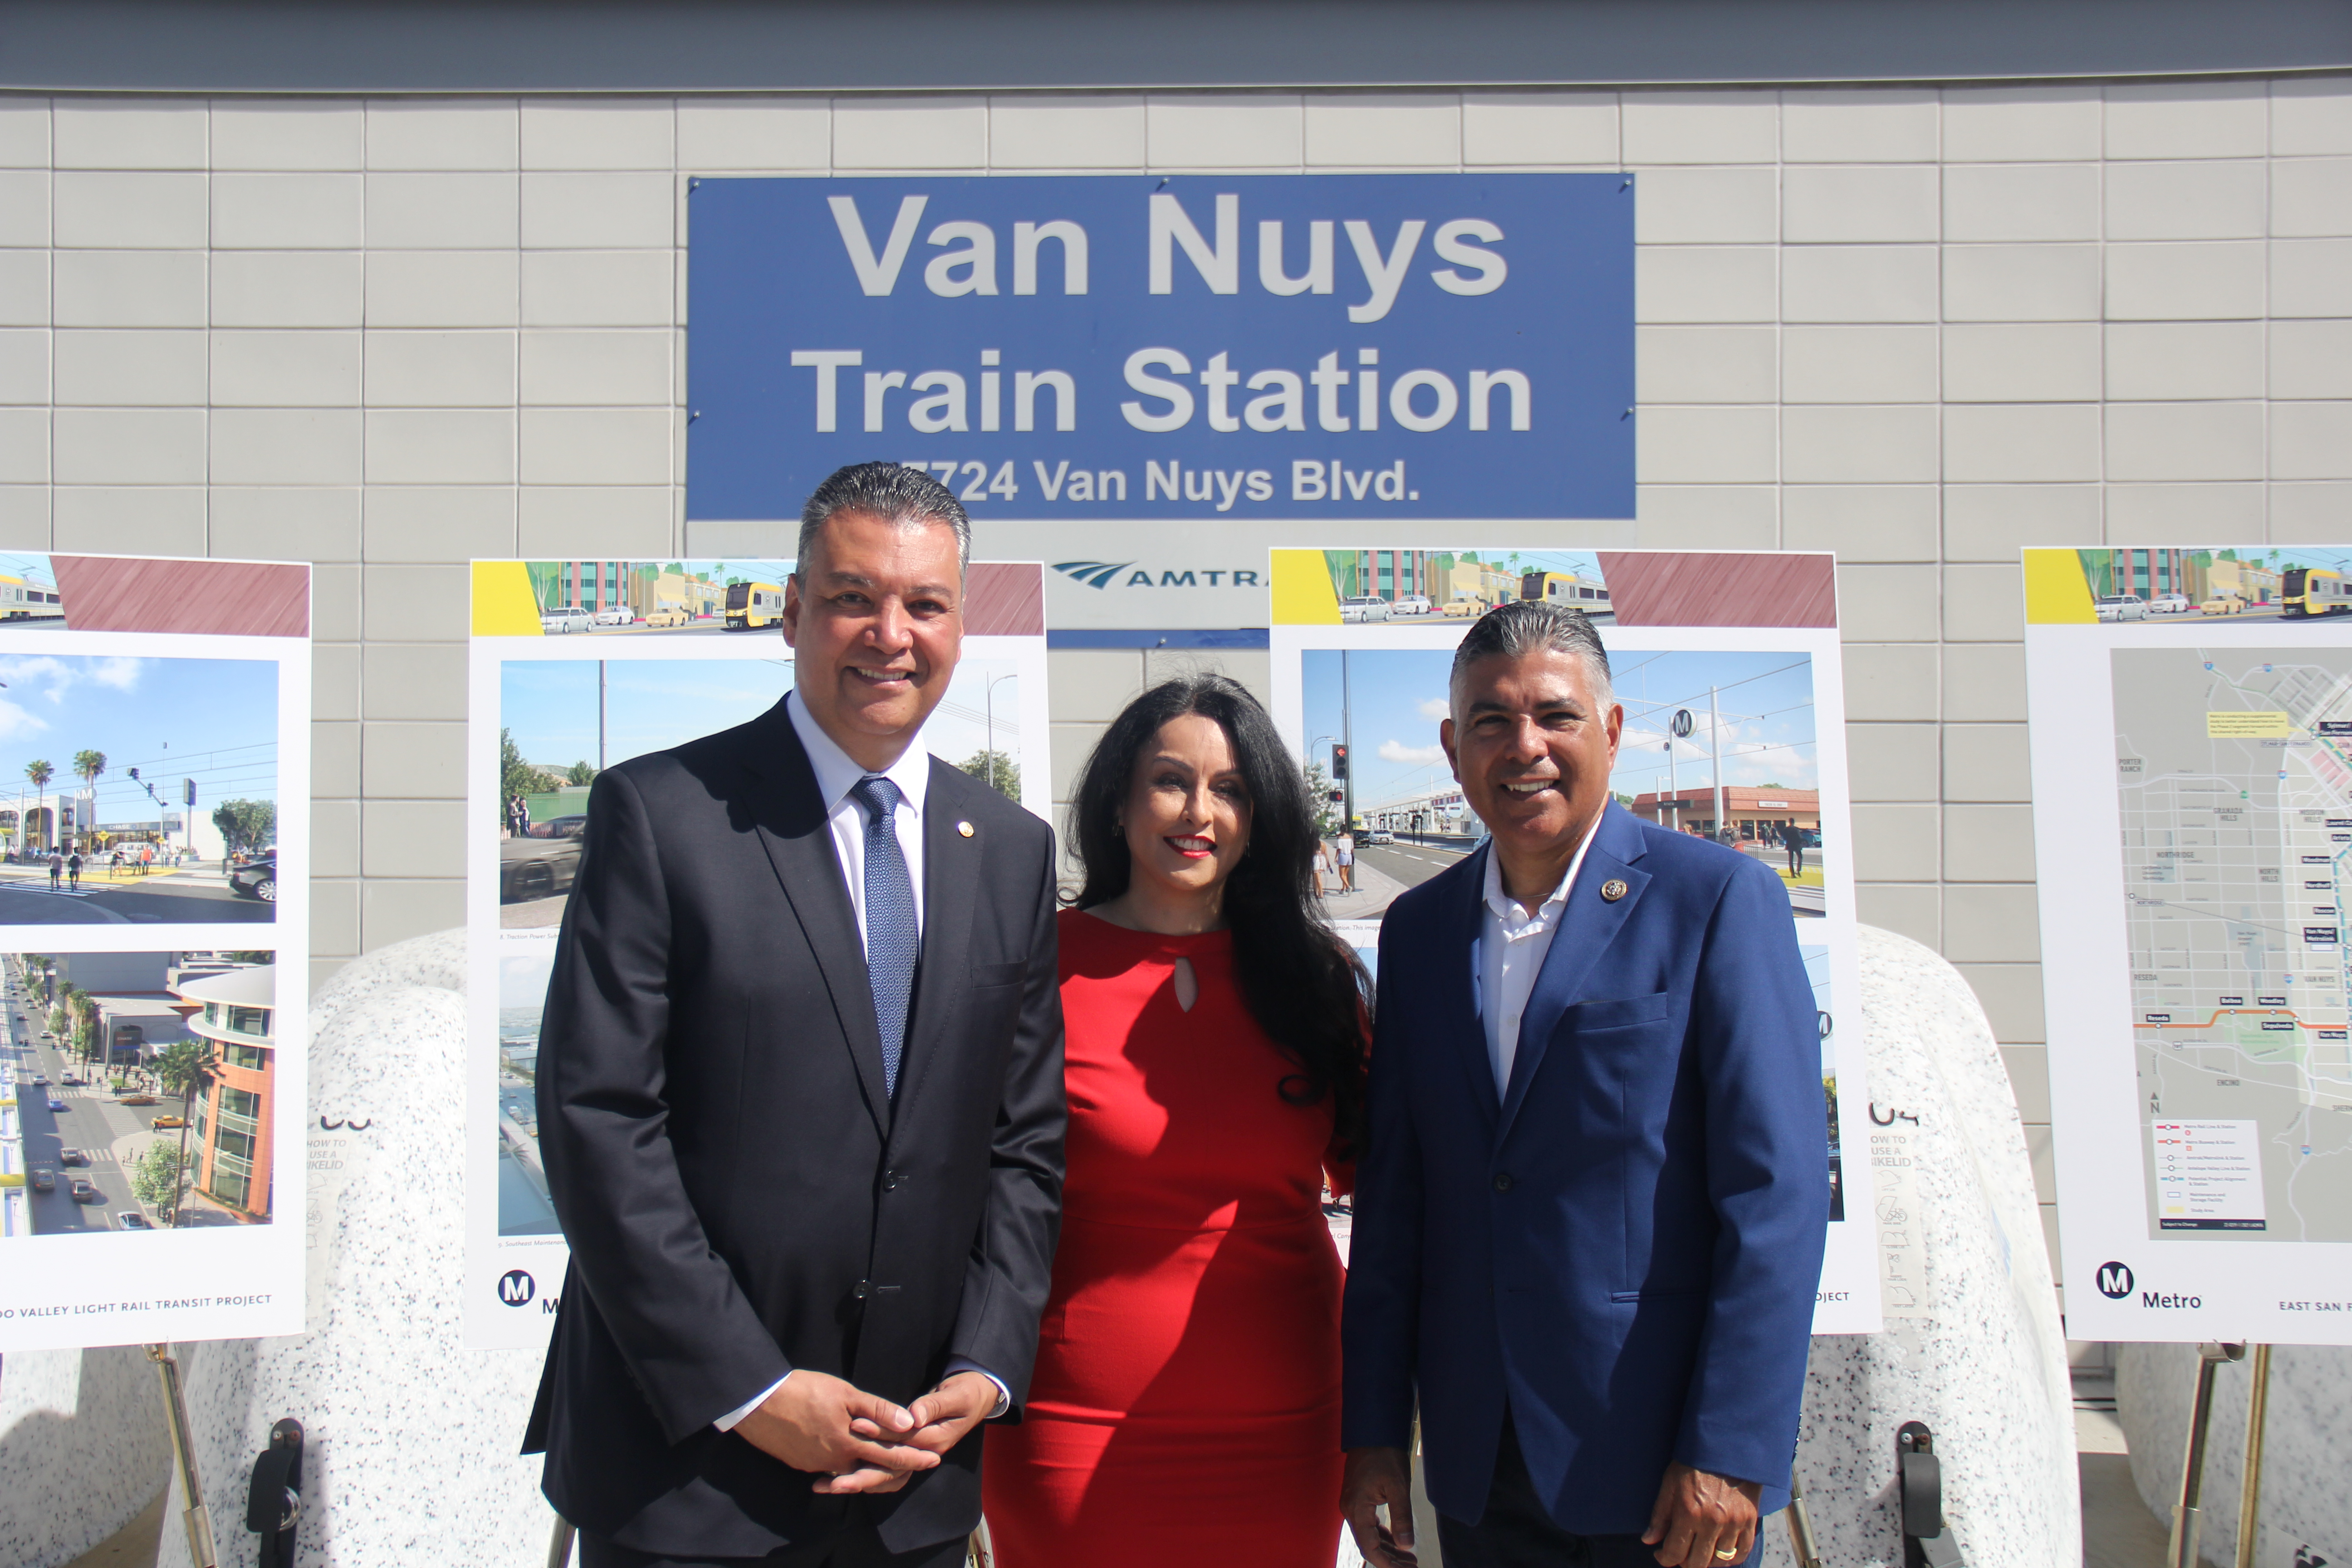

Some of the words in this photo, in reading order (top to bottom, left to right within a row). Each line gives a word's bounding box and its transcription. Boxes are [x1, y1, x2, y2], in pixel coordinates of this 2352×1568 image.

[827, 196, 1088, 298] Van
[1149, 194, 1508, 323] Nuys
[791, 349, 1076, 433] Train
[1120, 347, 1531, 432] Station
[902, 461, 1018, 502] 724
[1033, 461, 1126, 501] Van
[1146, 461, 1273, 512] Nuys
[1292, 461, 1420, 501] Blvd.
[1127, 571, 1269, 587] AMTR
[1675, 712, 1690, 735] M
[82, 788, 93, 800] M
[2150, 1102, 2160, 1114] N
[1892, 1135, 1906, 1144] TO
[309, 1150, 328, 1159] USE
[330, 1150, 337, 1158] A
[1871, 1147, 1891, 1155] USE
[1894, 1147, 1901, 1155] A
[307, 1160, 344, 1170] IKELID
[1871, 1157, 1911, 1167] IKELID
[505, 1276, 529, 1301] M
[2102, 1268, 2129, 1293] M
[20, 1307, 69, 1318] VALLEY
[74, 1303, 115, 1315] LIGHT
[121, 1302, 151, 1312] RAIL
[156, 1298, 211, 1310] TRANSIT
[216, 1295, 271, 1308] PROJECT
[2142, 1292, 2202, 1309] Metro
[2279, 1301, 2311, 1311] EAST
[2315, 1302, 2342, 1312] SAN
